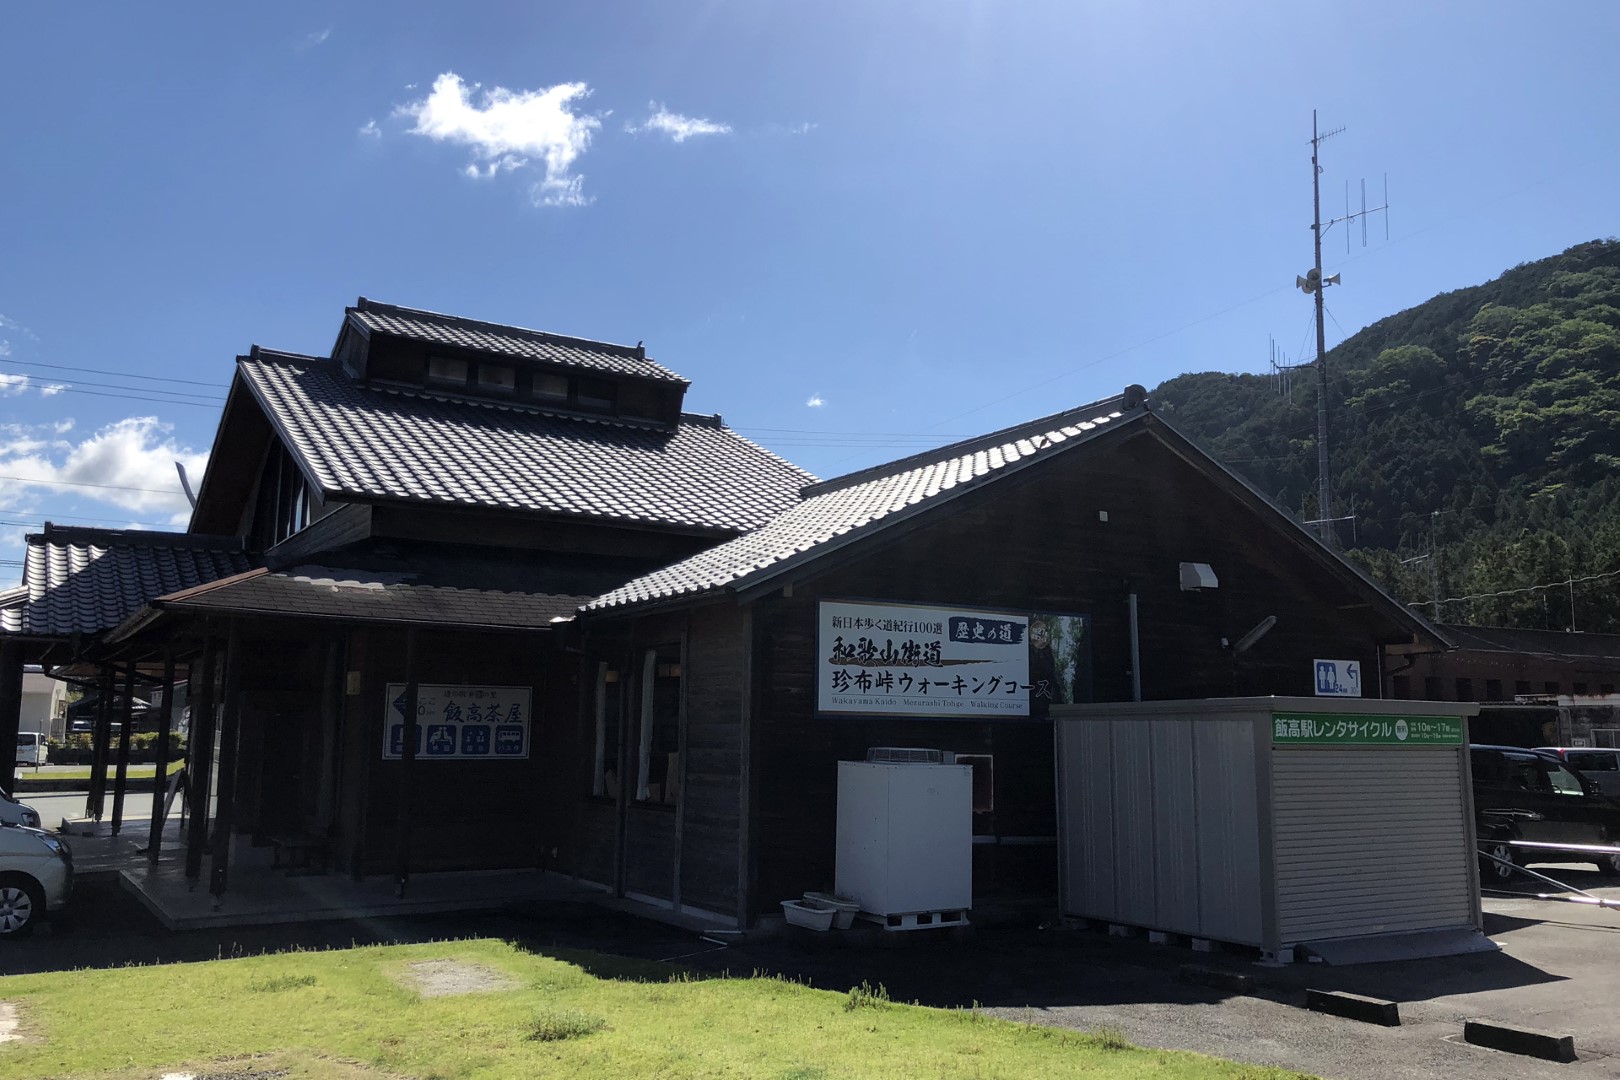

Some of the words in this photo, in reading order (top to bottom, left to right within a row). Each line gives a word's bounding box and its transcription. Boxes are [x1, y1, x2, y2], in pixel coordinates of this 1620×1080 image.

[831, 615, 943, 635] 新日本歩く道紀行100選
[955, 621, 1013, 642] 歴史の道
[832, 636, 943, 668] 和歌山街道
[831, 669, 1052, 699] 珍布峠ウォーキングコース
[443, 700, 523, 723] 飯高茶屋
[831, 696, 873, 706] Wakayama
[874, 697, 897, 706] Kaido
[903, 698, 941, 707] Mezurashi
[942, 699, 964, 709] Tohge
[970, 700, 998, 710] Walking
[999, 701, 1023, 710] Course
[1274, 718, 1391, 738] 飯高駅レンタサイクル
